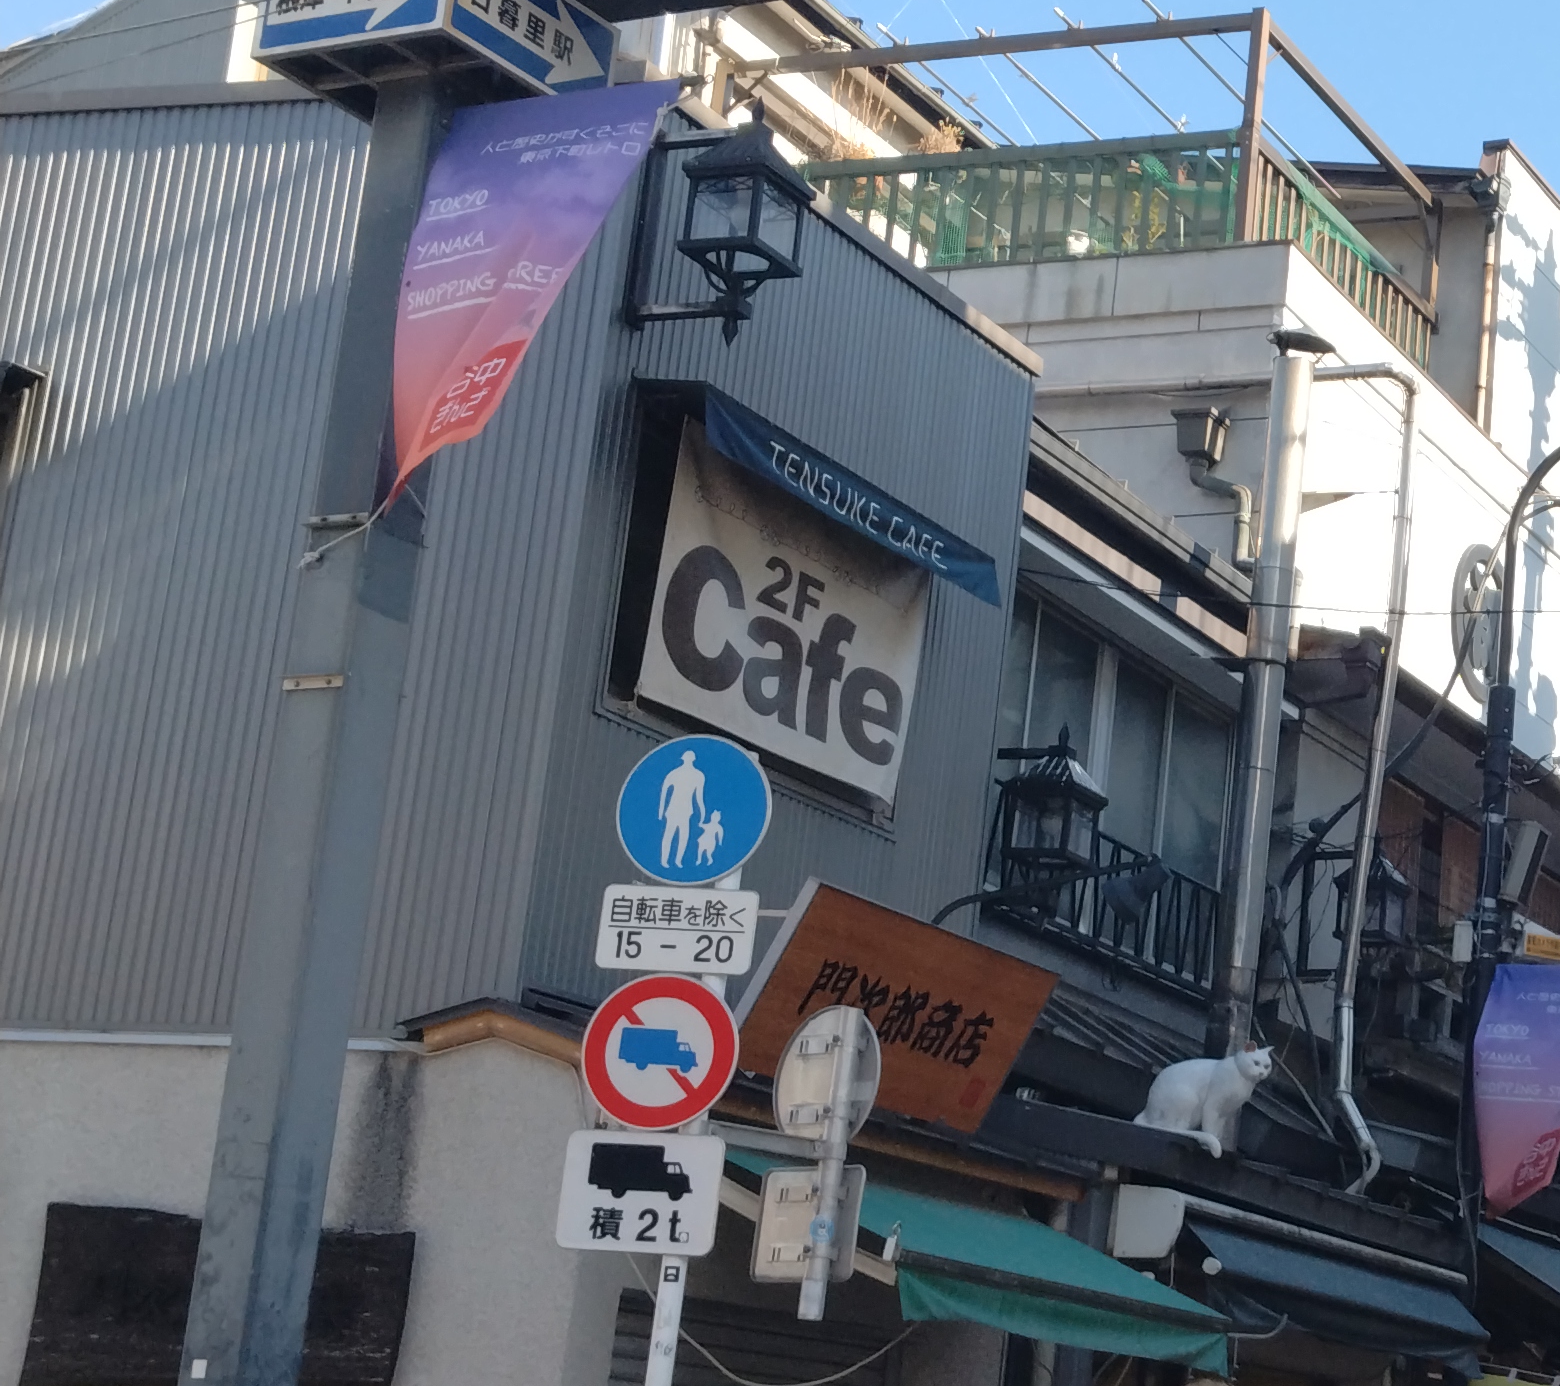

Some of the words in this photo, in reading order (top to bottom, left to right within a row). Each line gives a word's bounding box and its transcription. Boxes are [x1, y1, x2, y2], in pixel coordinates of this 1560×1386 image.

[517, 141, 641, 165] 東京下町レトロ
[427, 187, 489, 213] TOKYO
[416, 229, 487, 261] YANAKA
[406, 271, 496, 311] SHOPPING
[769, 439, 881, 536] TENSUKE
[888, 514, 949, 572] CAFE
[757, 555, 826, 624] 2F
[662, 544, 904, 767] Cafe
[610, 895, 746, 930] 自転車を除く
[614, 930, 642, 959] 15
[695, 934, 735, 964] 20
[1485, 1023, 1530, 1037] TOKYO
[1479, 1051, 1533, 1066] YANAKA
